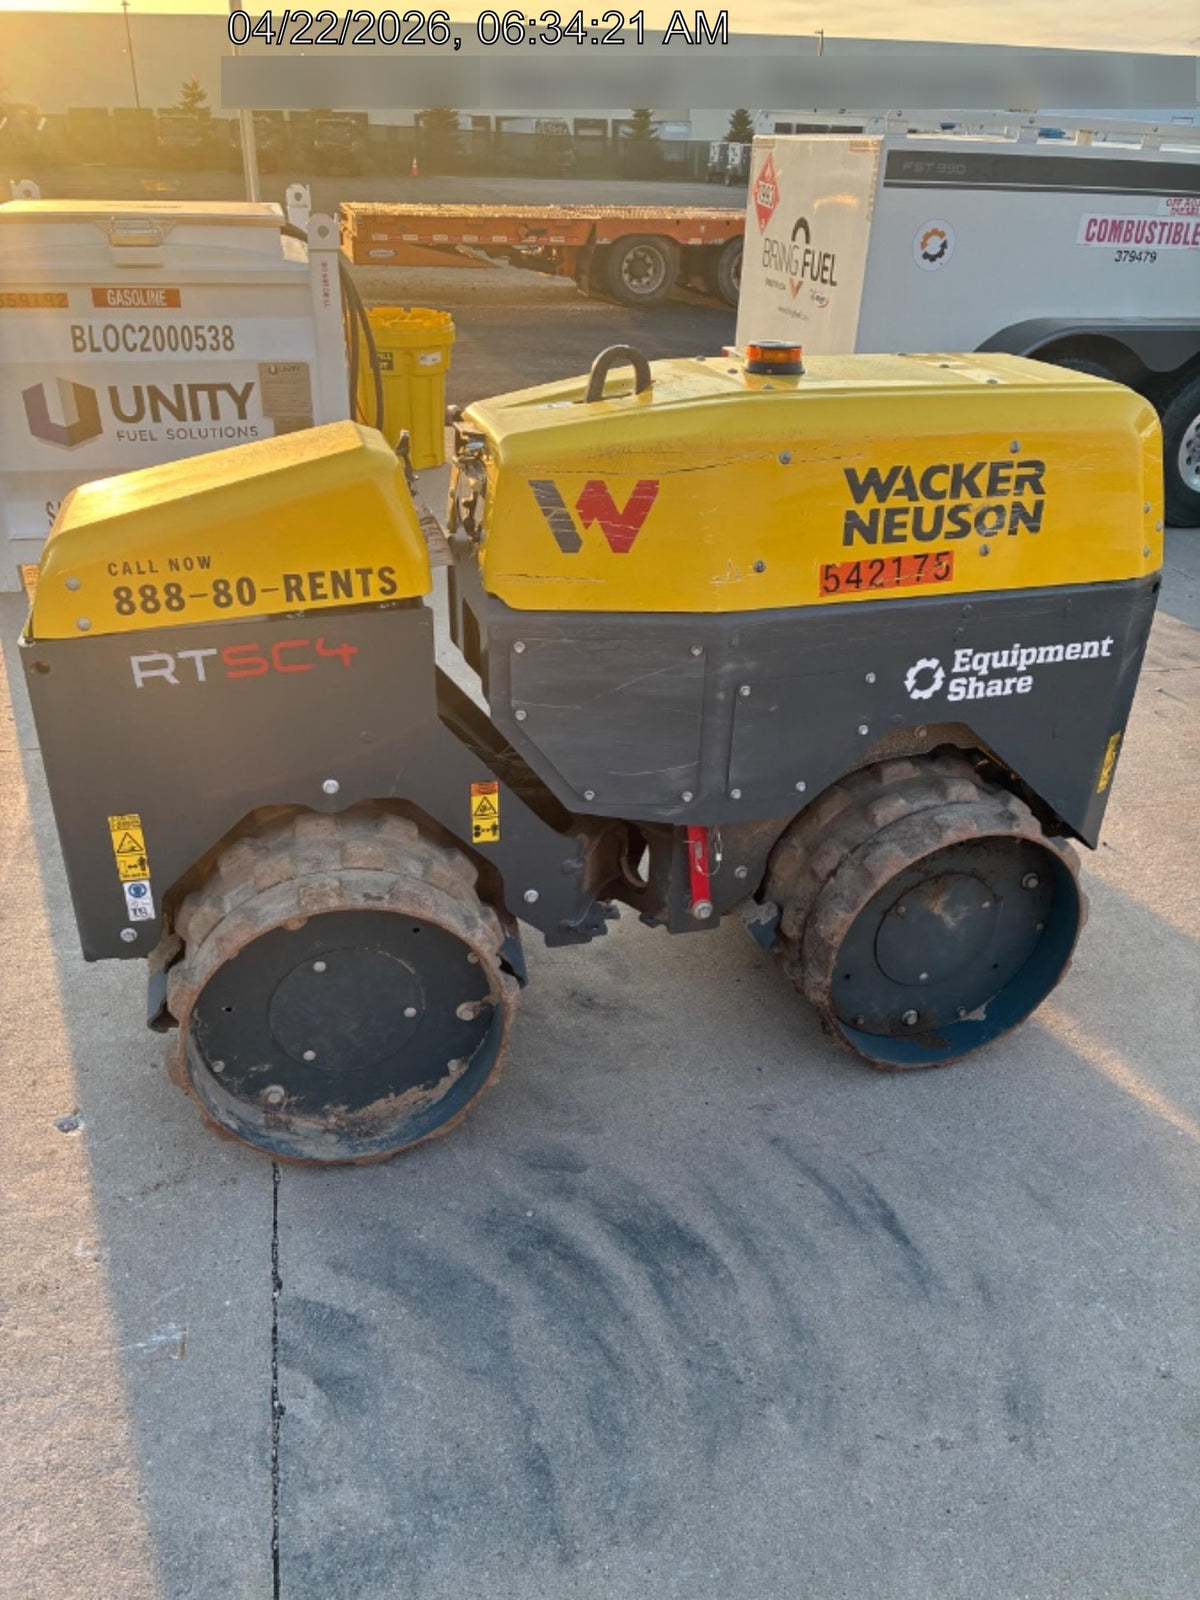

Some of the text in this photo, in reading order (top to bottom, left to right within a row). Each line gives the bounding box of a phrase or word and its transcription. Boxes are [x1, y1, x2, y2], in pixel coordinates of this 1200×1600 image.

[1084, 218, 1200, 246] COMBUSTIBLE
[801, 248, 838, 287] FUEL
[107, 289, 168, 307] GASOLINE
[70, 323, 235, 353] BLOC2000538
[107, 382, 255, 424] UNITY
[116, 425, 259, 442] FUEL SOLUTIONS
[844, 459, 1047, 504] WACKER
[842, 499, 1045, 547] NEUSON
[107, 555, 212, 577] CALL NOW
[823, 551, 951, 593] 542175
[113, 566, 398, 616] 888-80-RENTS
[130, 637, 358, 688] RTSC4
[951, 635, 1114, 676] Equipment
[947, 674, 1034, 702] Share
